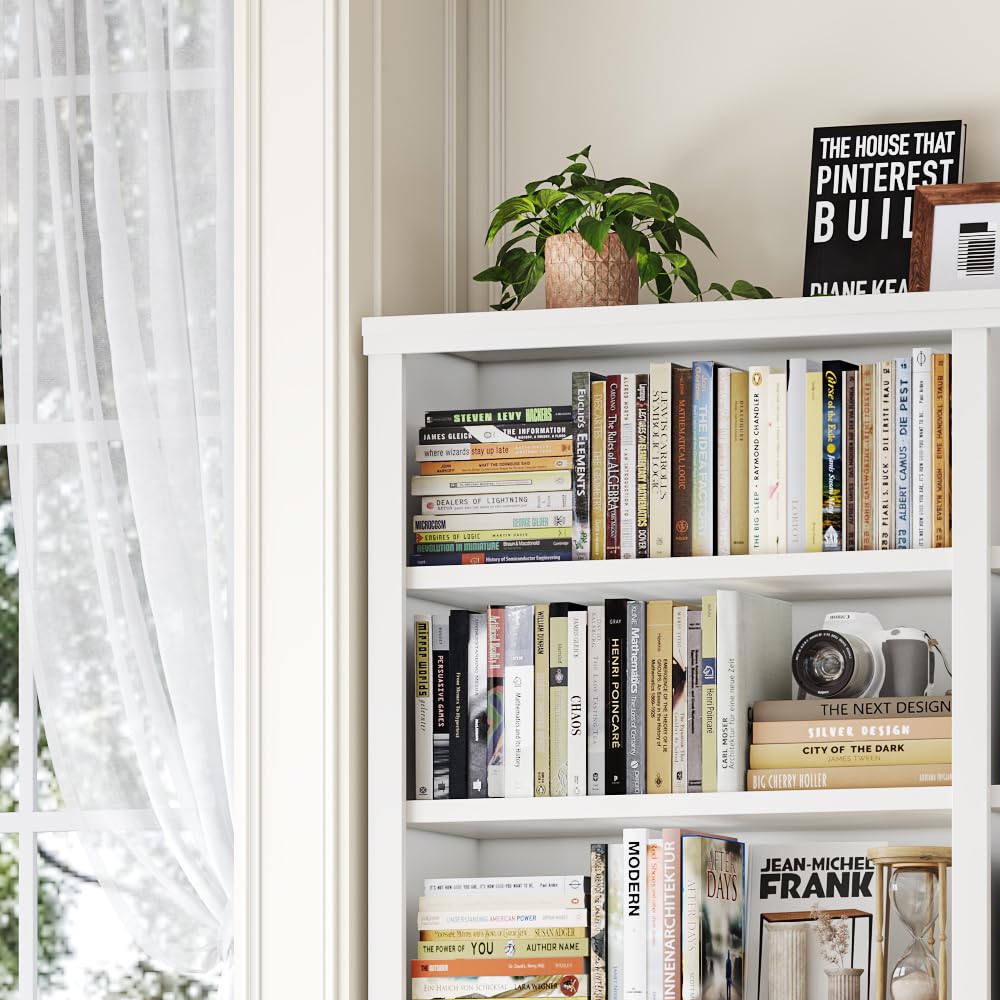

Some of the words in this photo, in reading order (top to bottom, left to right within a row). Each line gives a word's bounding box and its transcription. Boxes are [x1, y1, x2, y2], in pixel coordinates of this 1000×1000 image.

[820, 136, 851, 159] THE
[855, 134, 910, 158] HOUSE
[914, 131, 955, 154] THAT
[817, 159, 954, 195] PINTEREST
[814, 197, 913, 243] BUIL
[899, 379, 909, 411] PEST
[453, 412, 492, 422] STEVEN
[498, 412, 522, 421] LEVY
[526, 408, 552, 422] HACKERS
[899, 417, 908, 436] DIE
[446, 447, 469, 456] wizards
[472, 448, 484, 456] stay
[486, 448, 494, 456] up
[577, 433, 588, 496] ELEMENTS
[899, 446, 908, 480] CAMUS
[899, 485, 908, 520] ALBERT
[415, 520, 446, 529] MICROCOSM
[417, 623, 429, 657] mirror
[612, 638, 620, 678] HENRI
[417, 661, 429, 697] worlds
[571, 695, 581, 736] CHAOS
[612, 682, 621, 748] POINCARÉ
[821, 704, 848, 716] THE
[853, 703, 891, 715] NEXT
[896, 700, 950, 714] DESIGN
[808, 727, 854, 738] SILVER
[861, 725, 910, 736] DESIGN
[802, 746, 827, 754] CITY
[831, 746, 845, 754] OF
[851, 745, 871, 753] THE
[875, 744, 904, 752] DARK
[753, 776, 766, 789] BIG
[768, 774, 797, 788] CHERRY
[799, 773, 827, 787] HOLLER
[629, 842, 640, 916] MODERN
[761, 856, 875, 872] JEAN-MICHEL
[760, 872, 874, 899] FRANK
[664, 841, 676, 1000] INNENARCHITEKTUR
[436, 945, 455, 953] POWER
[471, 942, 494, 955] YOU
